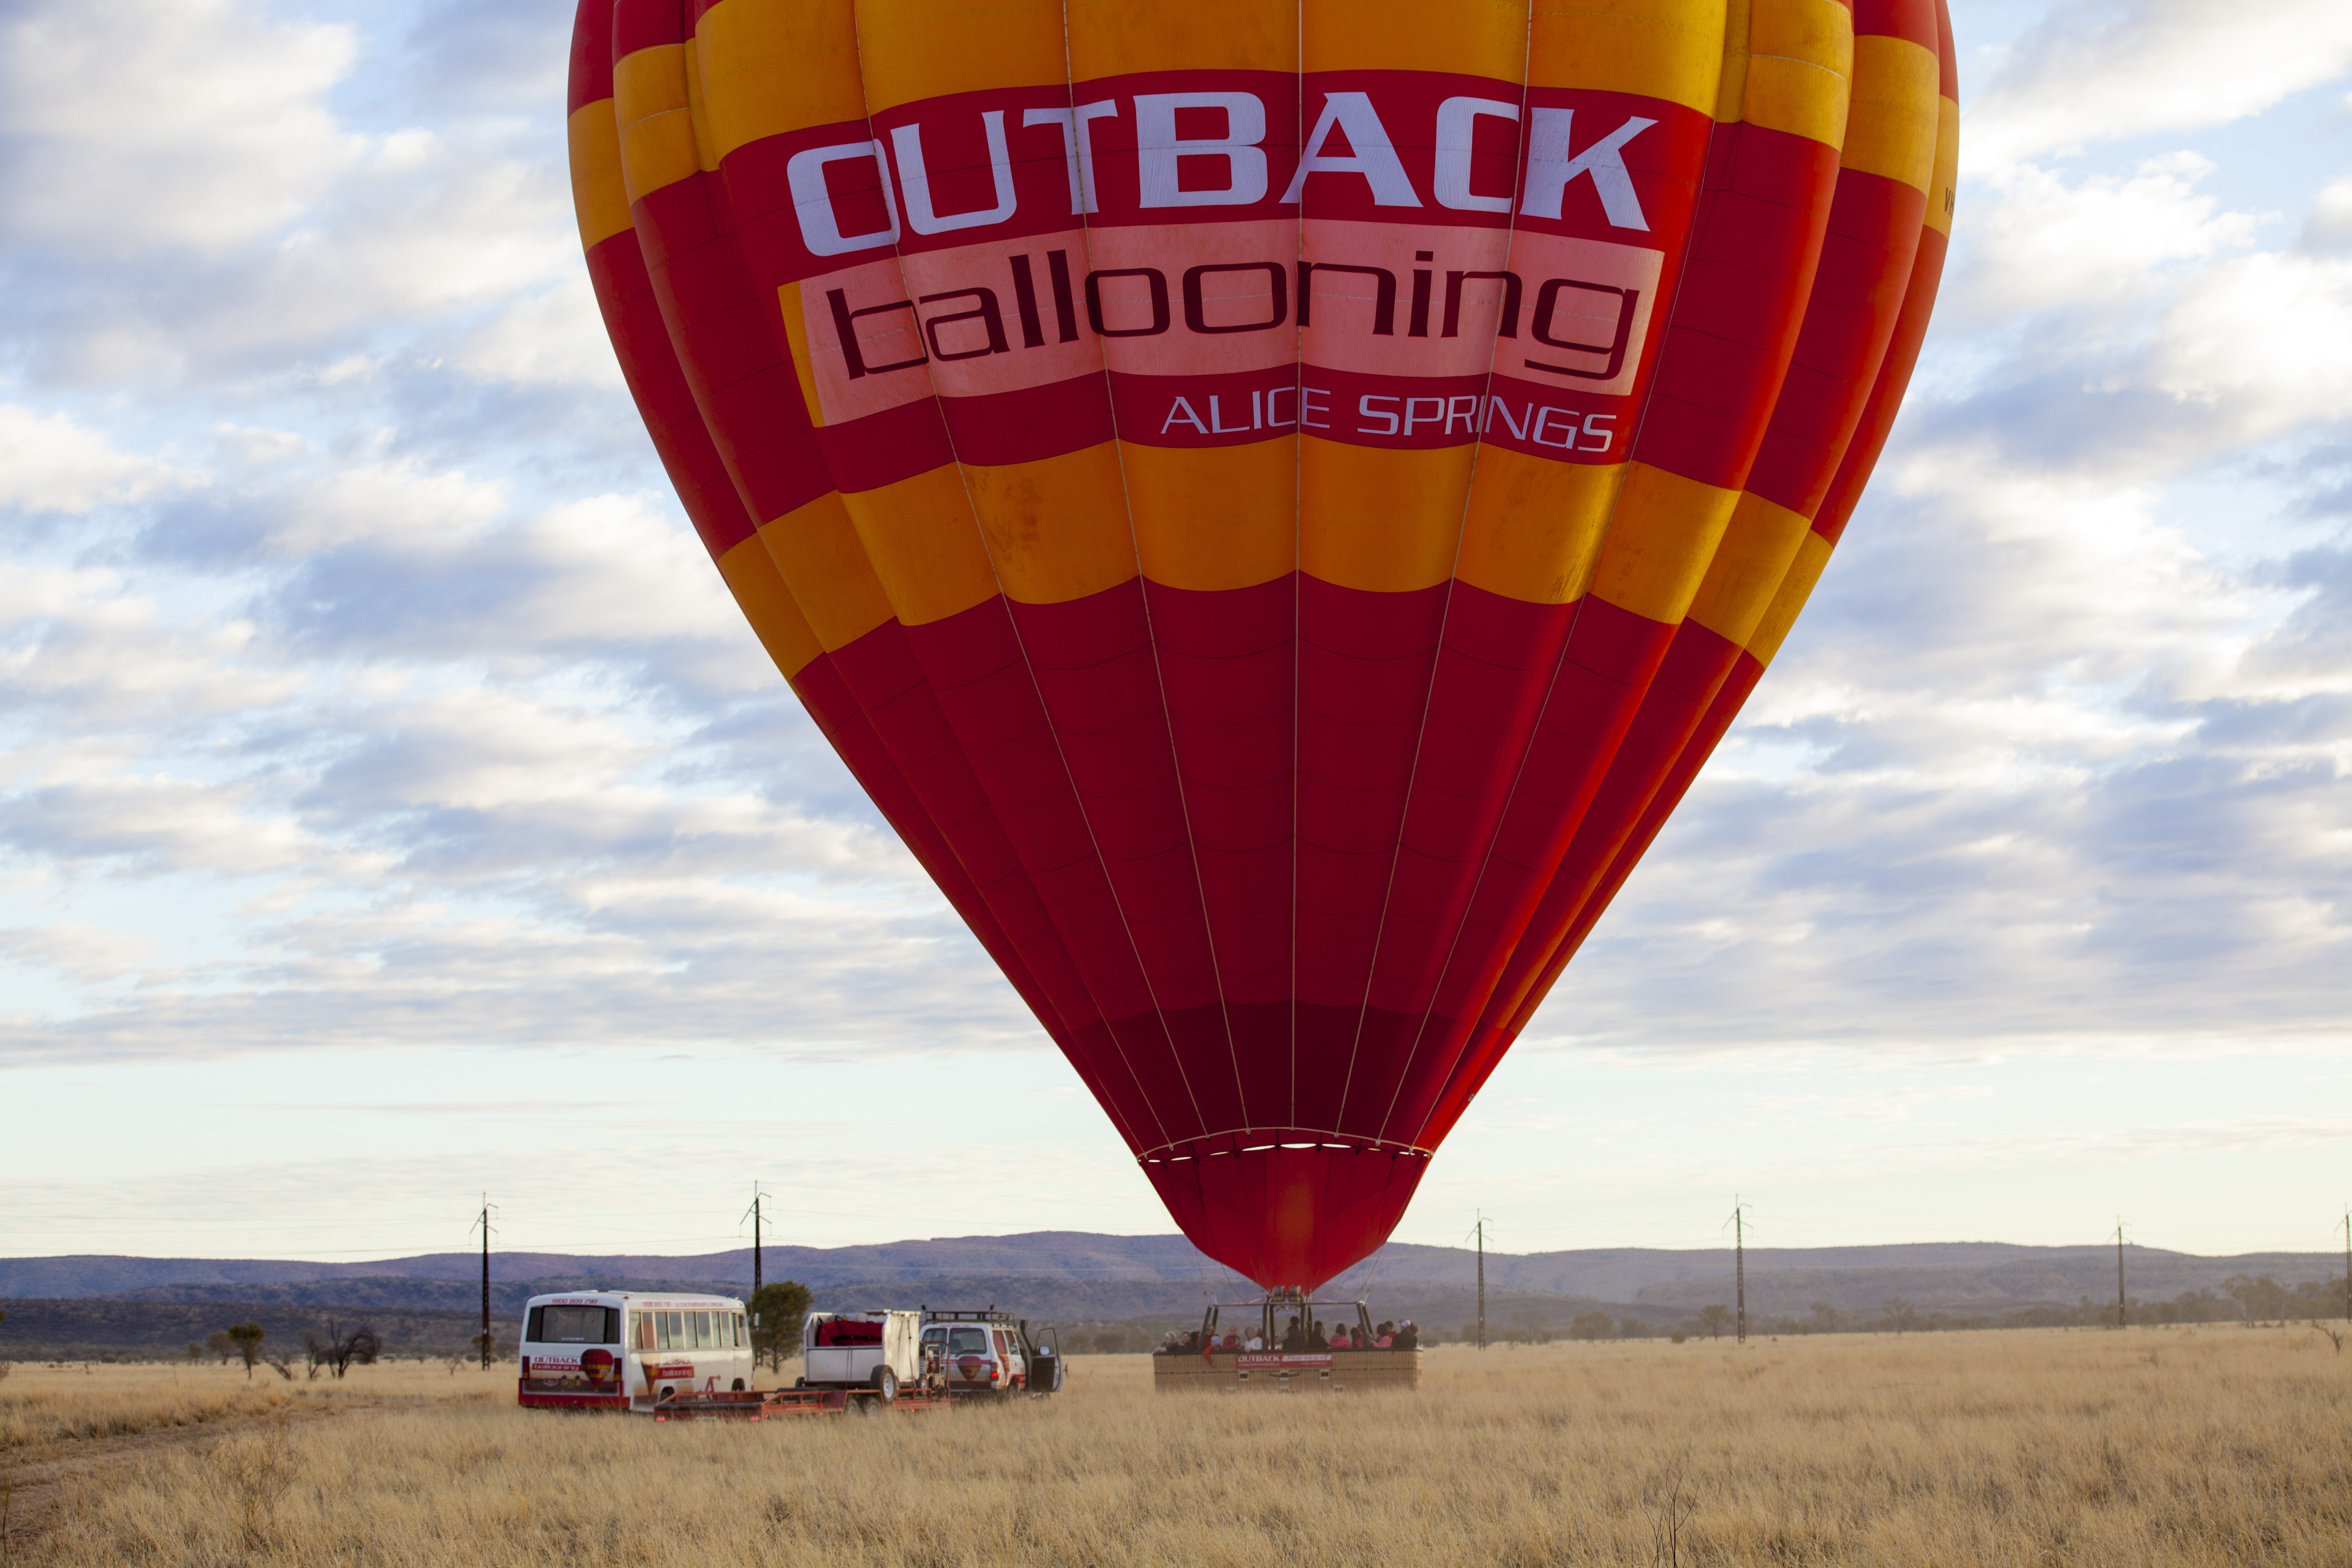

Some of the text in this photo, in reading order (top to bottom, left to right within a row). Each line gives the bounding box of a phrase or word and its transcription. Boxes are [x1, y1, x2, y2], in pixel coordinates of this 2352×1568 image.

[787, 91, 1659, 257] OUTBACK
[825, 249, 1640, 381] ballooning
[1160, 386, 1617, 453] ALICE SPRINGS
[662, 1369, 692, 1377] ballooning
